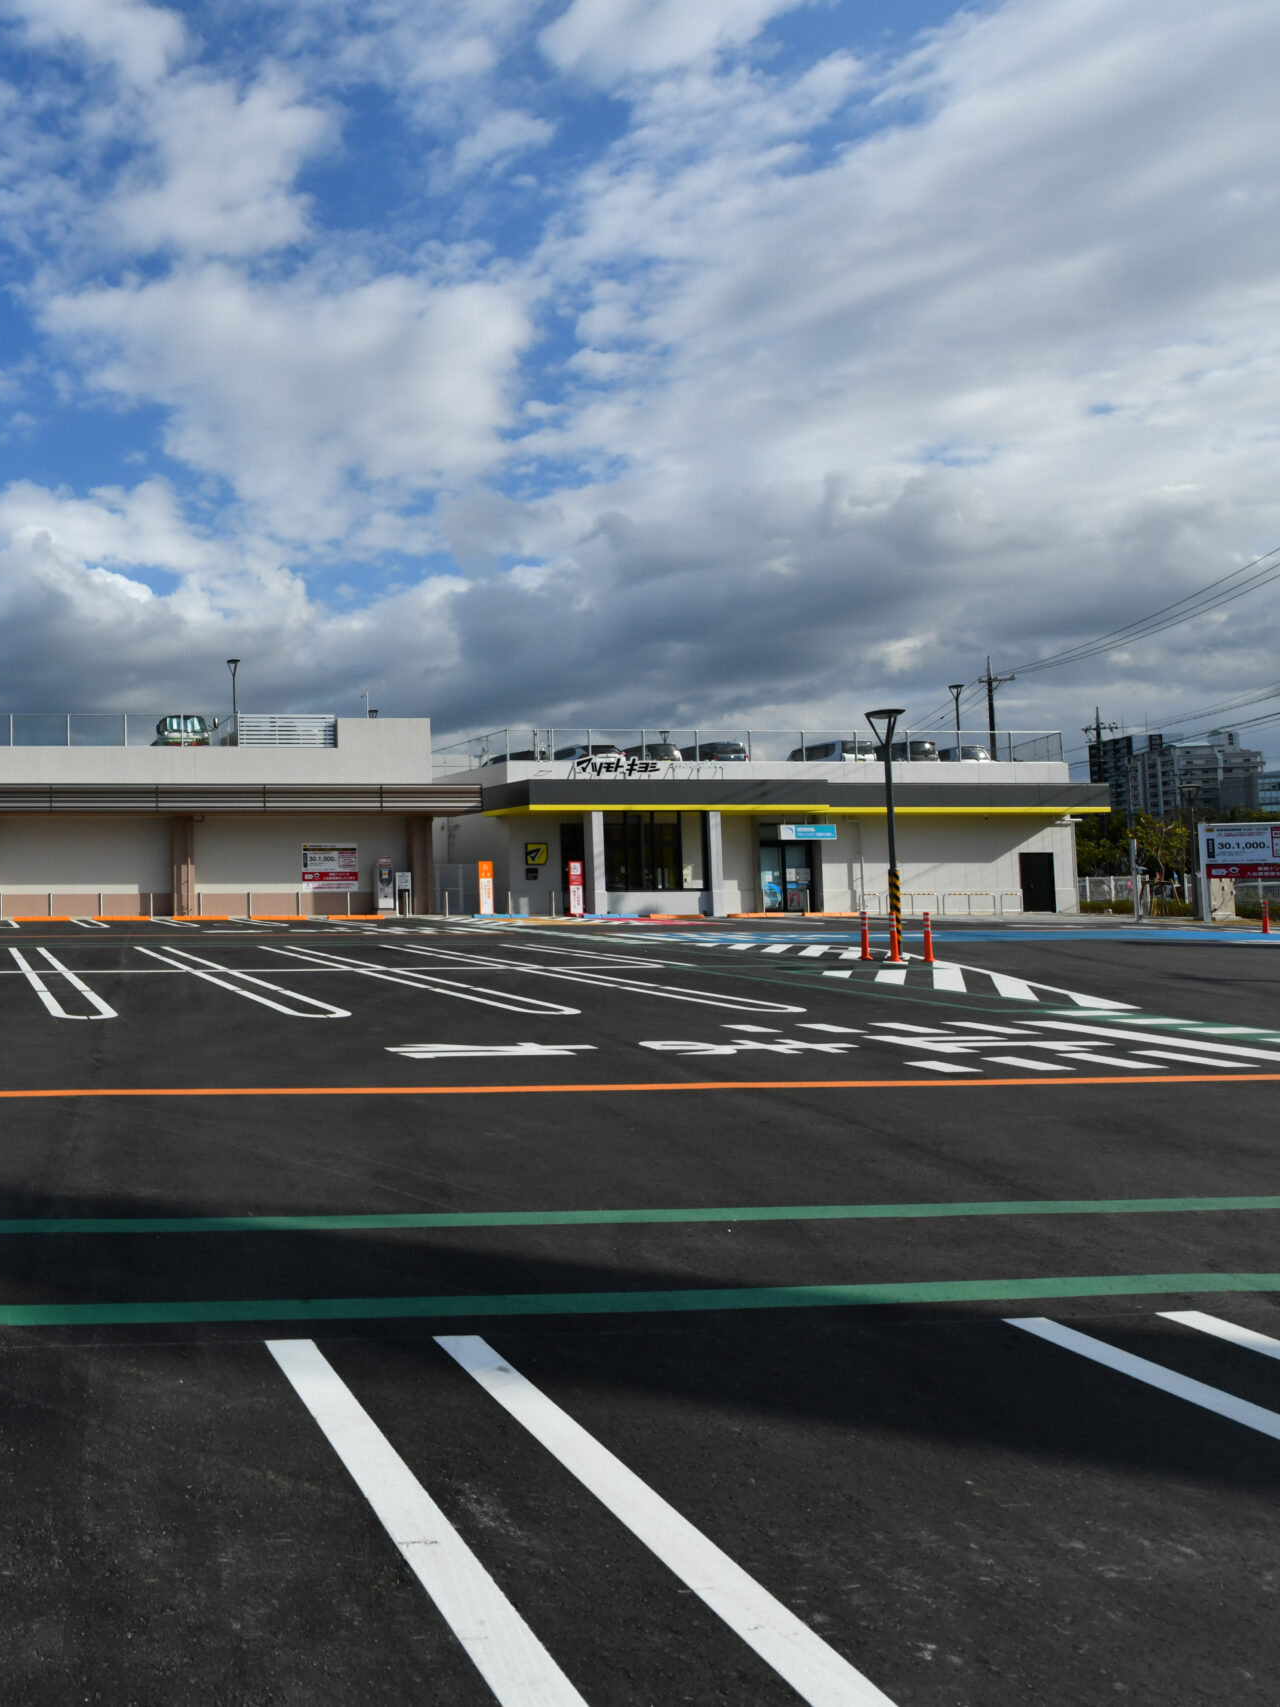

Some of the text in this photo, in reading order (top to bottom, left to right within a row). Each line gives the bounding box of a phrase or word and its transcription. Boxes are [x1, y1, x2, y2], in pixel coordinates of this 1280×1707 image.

[575, 756, 661, 777] マツモトキヨシ
